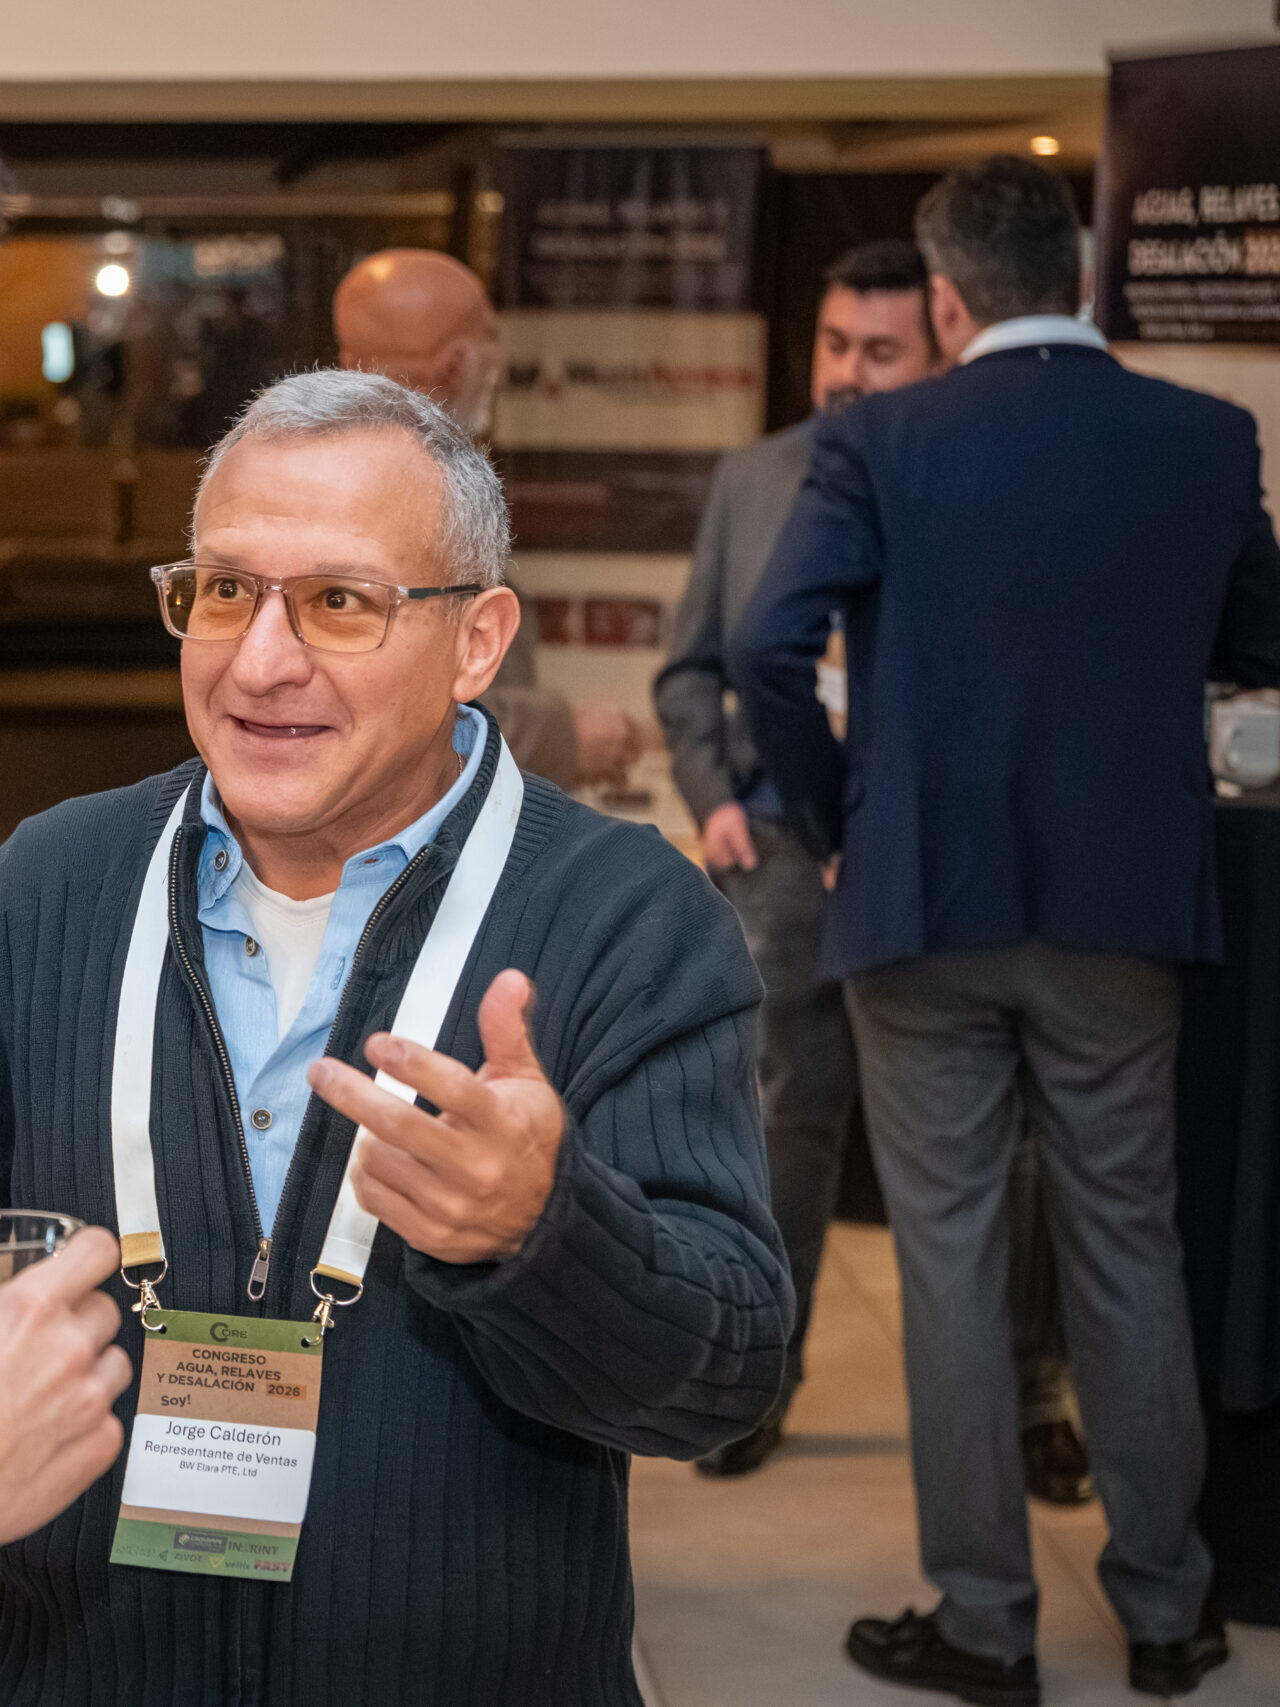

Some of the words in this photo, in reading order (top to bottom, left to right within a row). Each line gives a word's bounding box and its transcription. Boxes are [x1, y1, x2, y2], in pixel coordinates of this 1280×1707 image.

[192, 1349, 267, 1366] CONGRESO
[176, 1362, 217, 1377] AGUA,
[221, 1366, 281, 1381] RELAVES
[156, 1373, 166, 1383] Y
[168, 1374, 255, 1392] DESALACIÓN
[268, 1384, 301, 1397] 2026
[161, 1394, 191, 1408] Soy!
[165, 1421, 206, 1441] Jorge
[210, 1425, 281, 1446] Calderón
[144, 1441, 234, 1461] Representante
[237, 1450, 252, 1463] de
[256, 1453, 298, 1468] Ventas
[179, 1460, 195, 1471] BW
[196, 1462, 220, 1473] Elara
[221, 1465, 241, 1477] PTE,
[242, 1467, 258, 1478] Ltd
